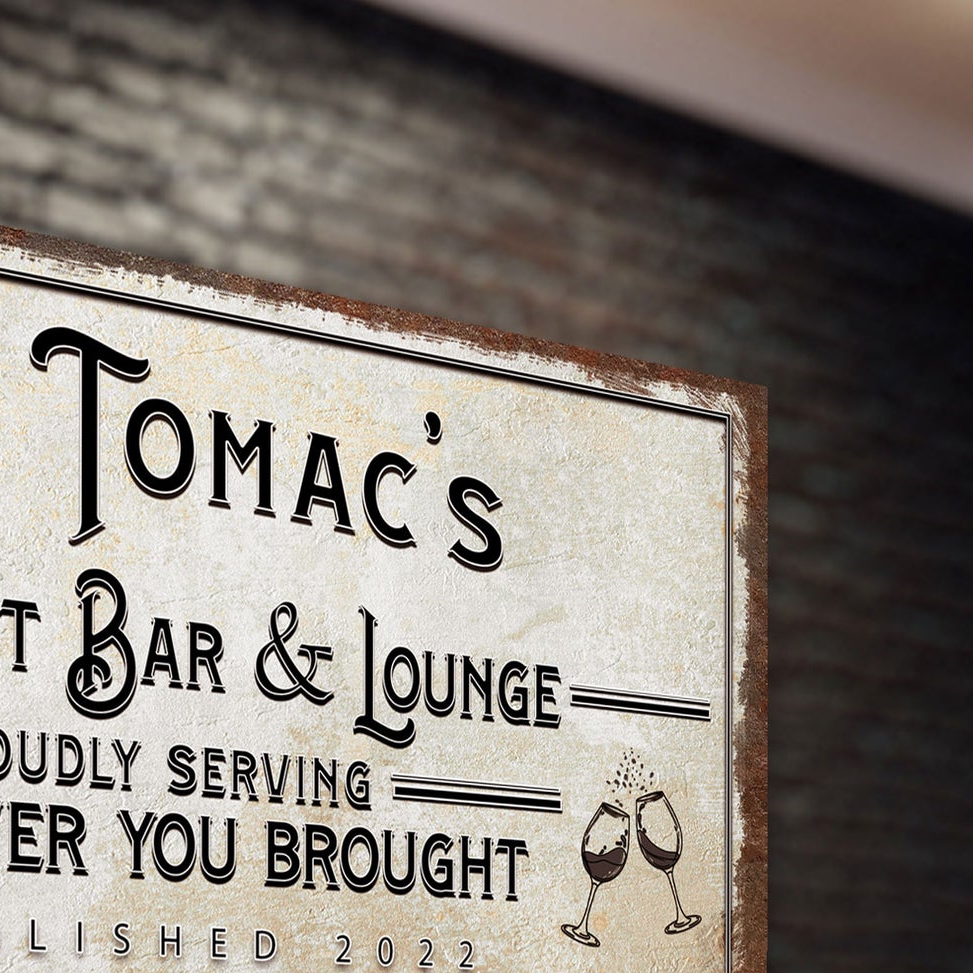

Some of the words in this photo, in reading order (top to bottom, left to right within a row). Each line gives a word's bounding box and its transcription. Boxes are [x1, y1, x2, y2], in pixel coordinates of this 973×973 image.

[30, 326, 504, 571] TOMAC'S
[66, 568, 225, 720] BAR
[254, 601, 333, 706] &
[353, 606, 562, 748] LOUNGE
[167, 743, 371, 810] SERVING
[116, 808, 239, 885] YOU
[265, 820, 529, 901] BROUGHT
[335, 935, 475, 968] 2022
